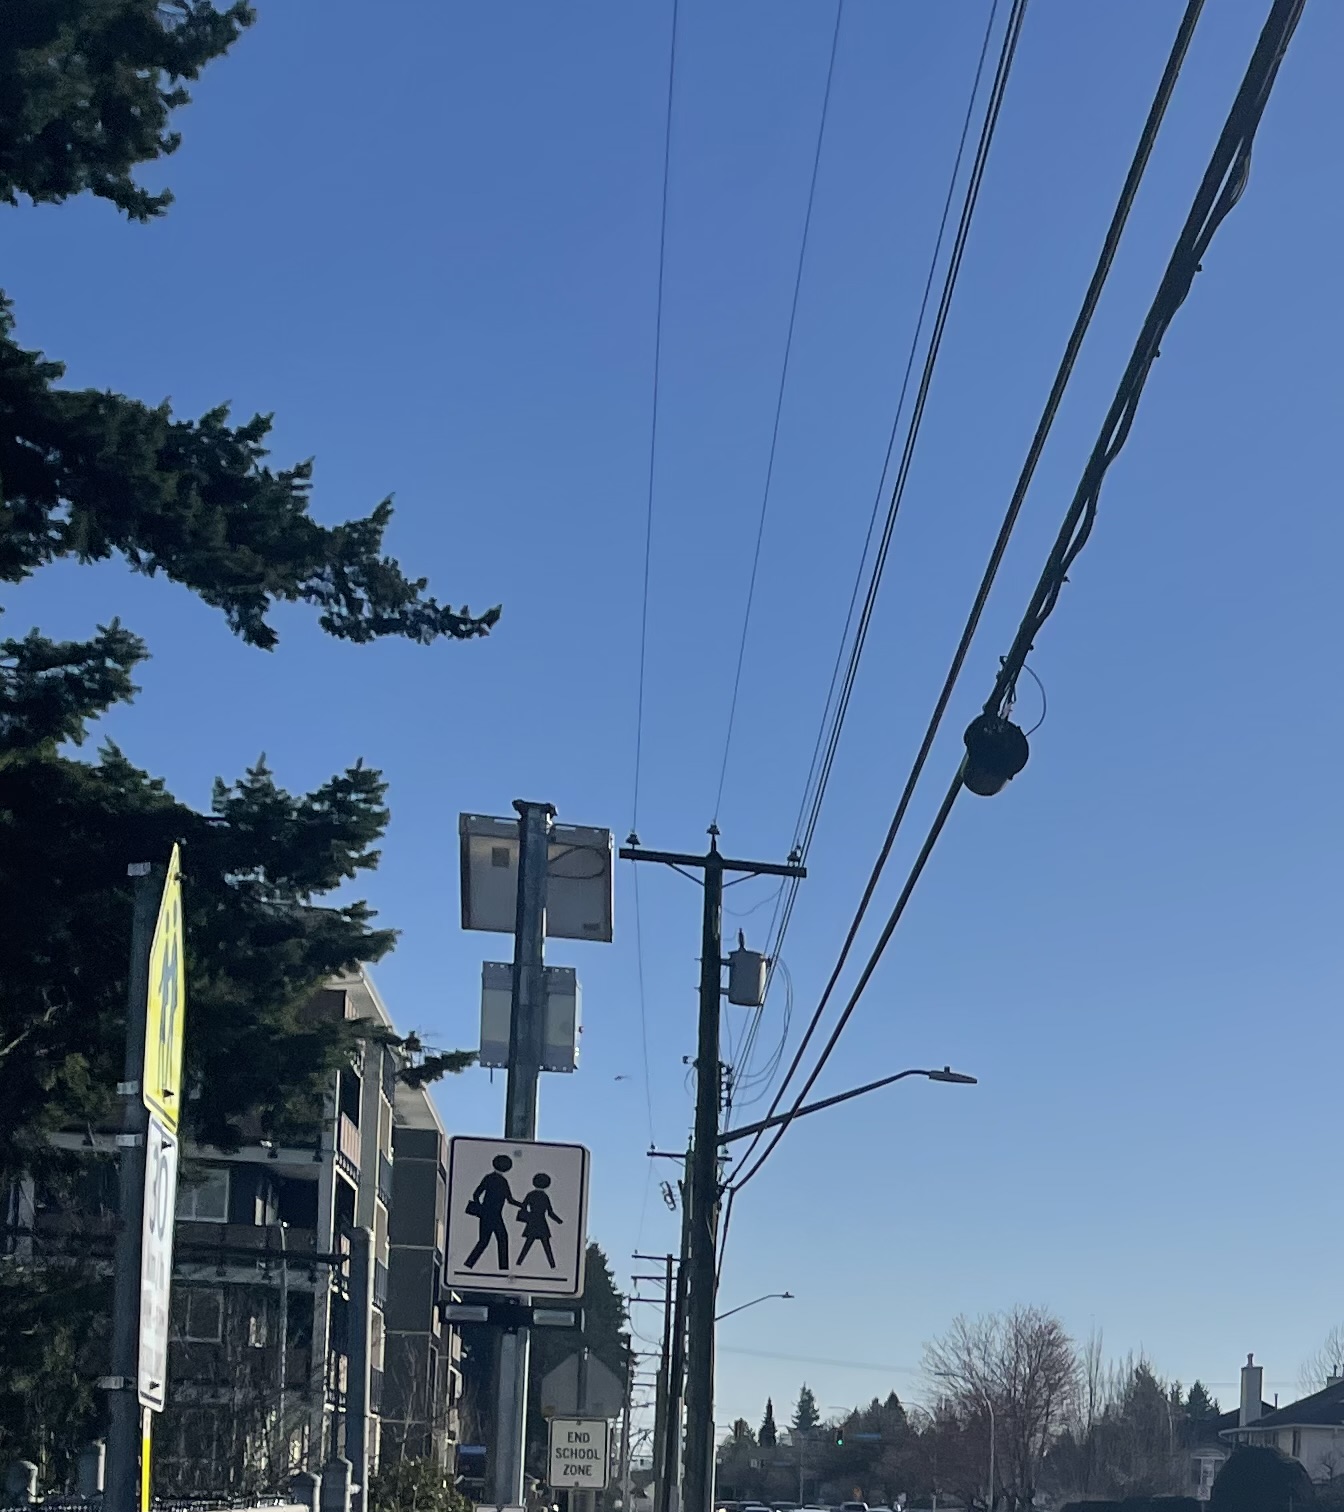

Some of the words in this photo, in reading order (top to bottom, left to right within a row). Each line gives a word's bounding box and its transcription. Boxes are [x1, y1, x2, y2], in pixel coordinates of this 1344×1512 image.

[149, 1145, 169, 1242] 30
[567, 1431, 590, 1443] END
[555, 1447, 601, 1460] SCHOOL
[563, 1463, 593, 1476] ZONE
